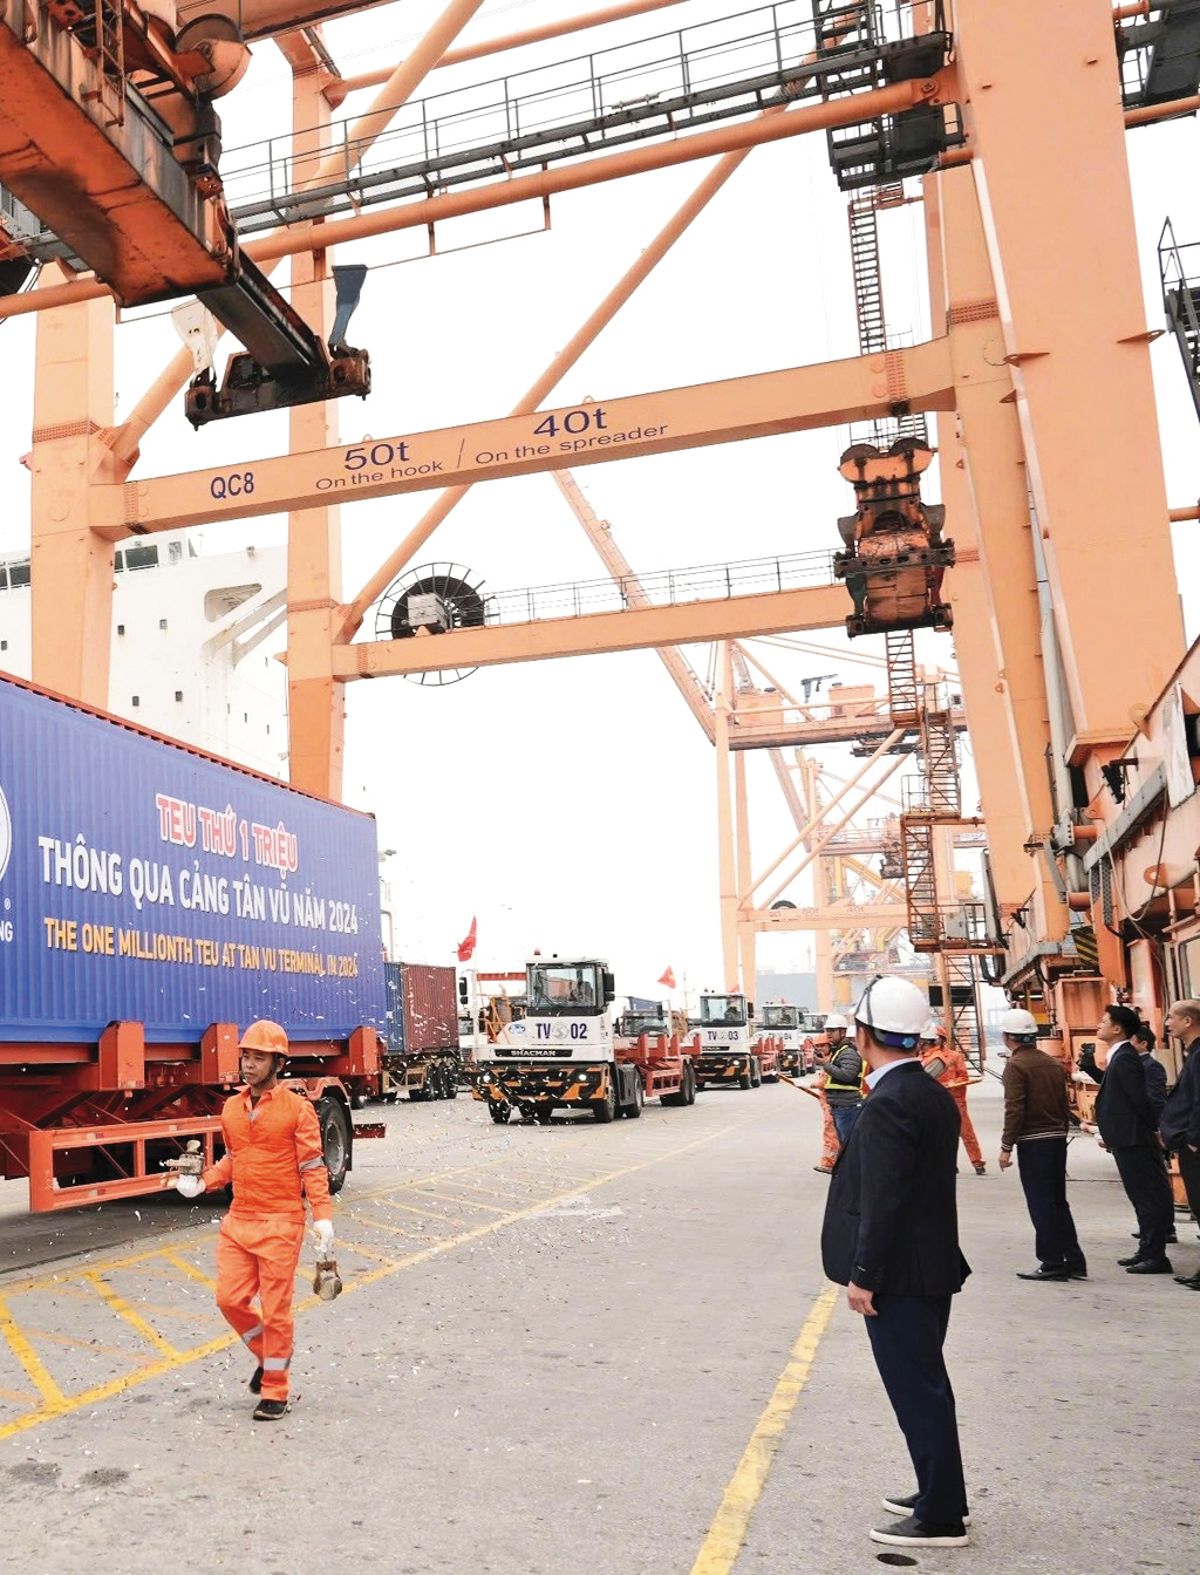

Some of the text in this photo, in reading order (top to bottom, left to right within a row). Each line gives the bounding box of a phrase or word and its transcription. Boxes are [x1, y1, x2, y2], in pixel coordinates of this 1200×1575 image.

[533, 408, 607, 437] 40t
[344, 441, 410, 470] 50t
[475, 425, 668, 464] On the spreader
[210, 472, 255, 499] QC8
[316, 460, 443, 490] On the hook
[156, 793, 298, 880] TEU THỨ 1 TRIỆU
[38, 833, 123, 896] THÔNG
[129, 857, 175, 910] QUA
[179, 860, 229, 915] CẢNG
[233, 874, 266, 921] TÂN
[294, 887, 326, 930] NĂM
[329, 900, 358, 935] 2024
[44, 917, 77, 951] THE
[81, 923, 115, 955] ONE
[119, 928, 193, 963] MILLIONTH
[195, 938, 219, 967] TEU
[222, 942, 236, 967] AT
[236, 944, 260, 969] TAN
[262, 947, 277, 971] VU
[279, 949, 325, 975] TERMINAL
[536, 1023, 551, 1039] TV
[570, 1023, 587, 1039] 02
[708, 1030, 739, 1040] TV 03
